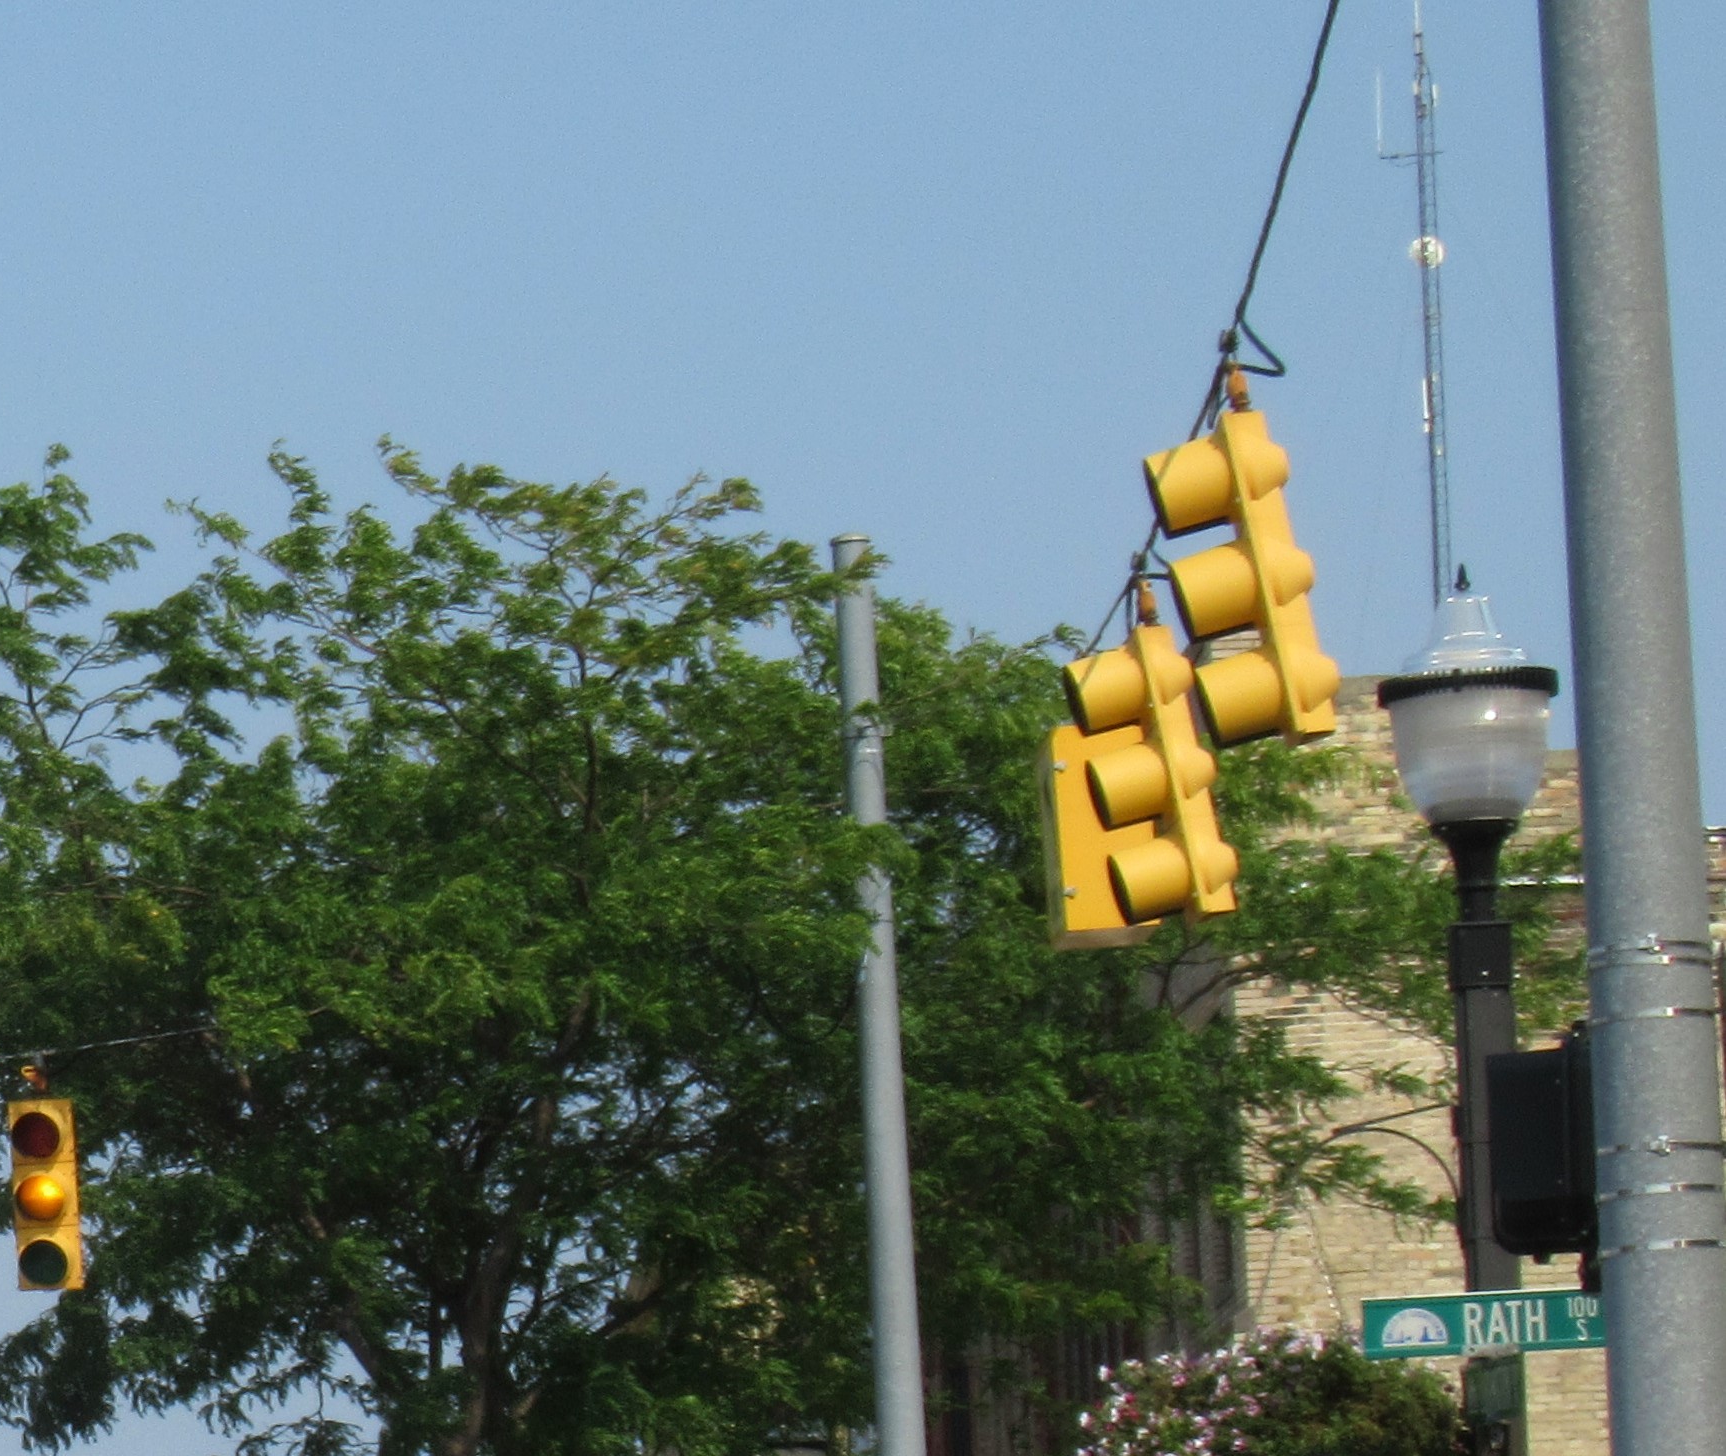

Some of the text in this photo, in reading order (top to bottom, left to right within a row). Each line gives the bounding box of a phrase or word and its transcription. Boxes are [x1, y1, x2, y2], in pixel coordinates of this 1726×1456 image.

[1463, 1299, 1546, 1346] RATH
[1567, 1297, 1598, 1318] 100
[1576, 1319, 1589, 1341] S
